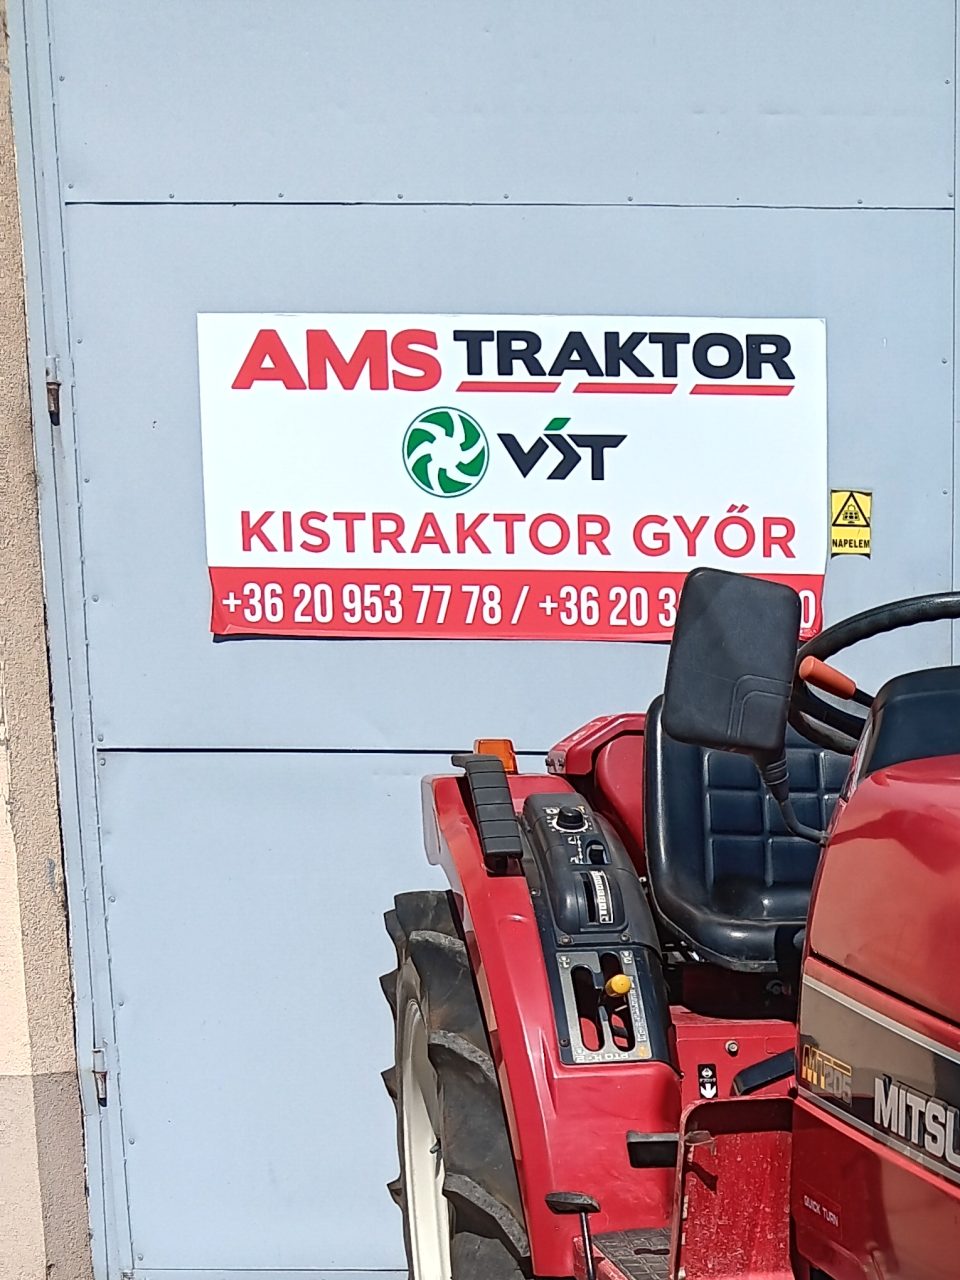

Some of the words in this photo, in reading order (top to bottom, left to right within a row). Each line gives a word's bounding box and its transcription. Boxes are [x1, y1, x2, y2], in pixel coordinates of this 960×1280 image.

[232, 329, 442, 391] AMS
[453, 330, 796, 379] TRAKTOR
[241, 511, 611, 555] KISTRAKTOR
[633, 504, 796, 558] GYŐR
[832, 538, 870, 548] NAPELEM
[222, 583, 283, 622] +36
[293, 584, 332, 622] 20
[342, 584, 402, 623] 953
[413, 585, 451, 623] 77
[462, 586, 501, 624] 78
[538, 586, 599, 625] +36
[609, 587, 648, 626] 20
[658, 588, 682, 626] 3
[802, 1044, 852, 1105] MT205
[804, 1195, 821, 1215] QUICK
[822, 1206, 839, 1227] TURN
